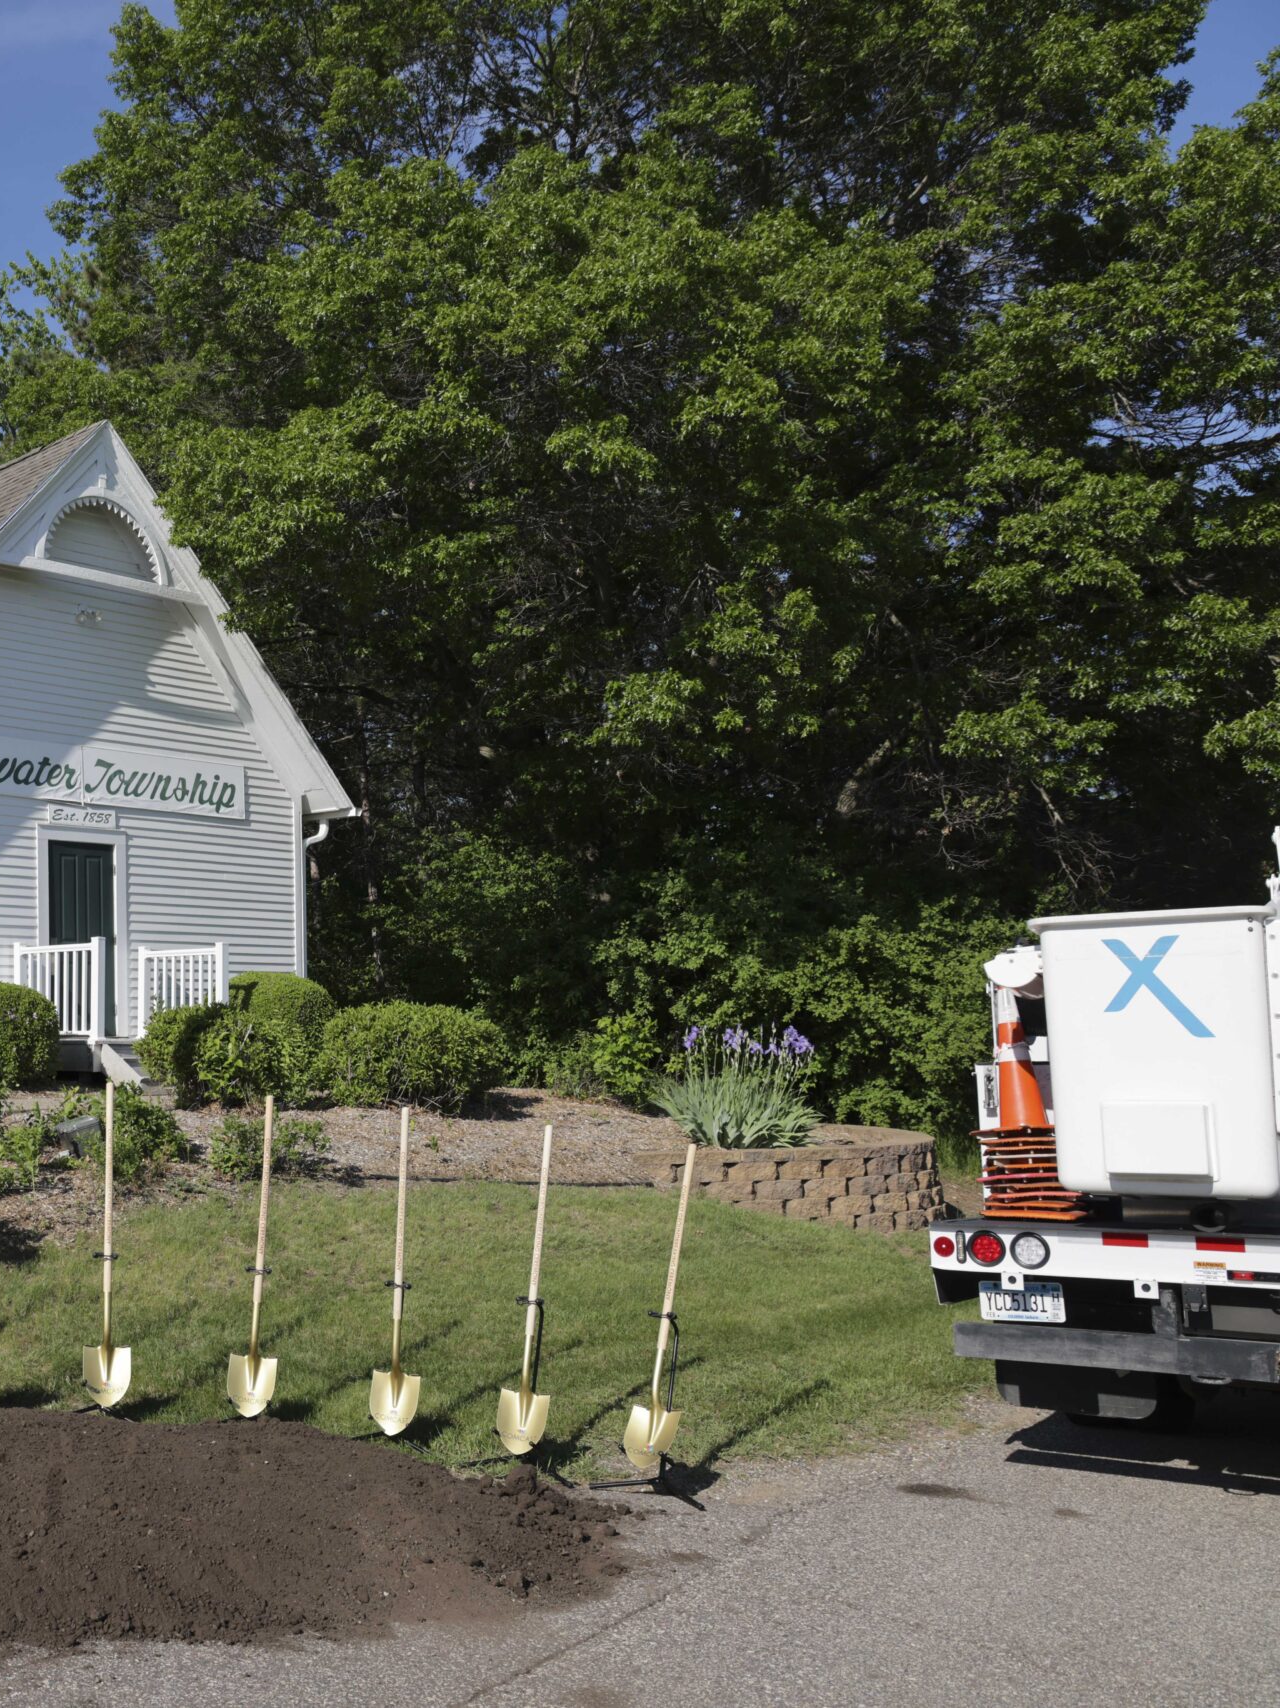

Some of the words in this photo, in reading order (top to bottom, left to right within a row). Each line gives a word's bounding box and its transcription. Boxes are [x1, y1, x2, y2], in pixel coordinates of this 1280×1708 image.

[83, 758, 236, 813] Township
[52, 808, 80, 822] Est.
[83, 810, 111, 824] 1858
[985, 1291, 1048, 1313] YCC5131
